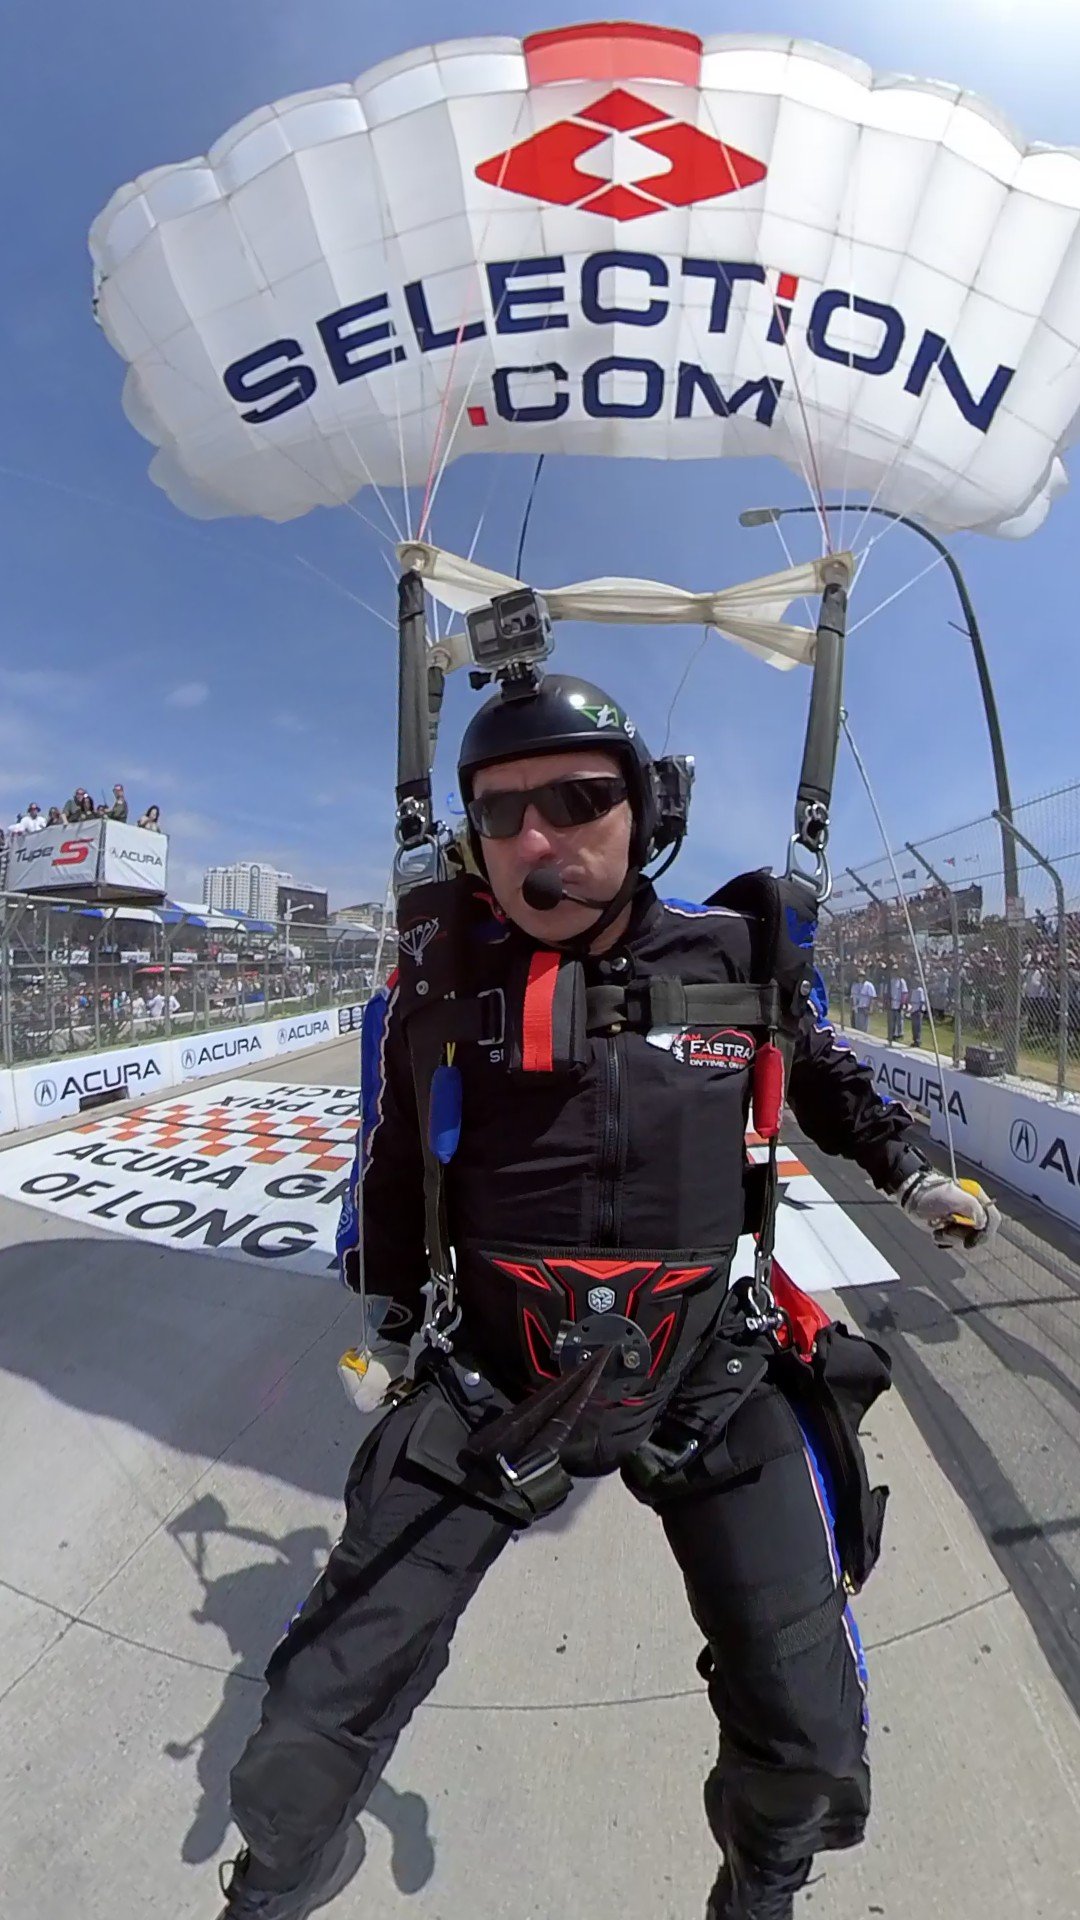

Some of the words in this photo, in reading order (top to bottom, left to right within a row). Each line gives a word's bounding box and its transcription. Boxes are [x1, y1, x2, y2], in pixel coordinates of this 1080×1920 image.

[119, 849, 163, 867] ACURA
[287, 1018, 330, 1042] ACURA
[198, 1035, 262, 1065] ACURA
[690, 1040, 752, 1059] FASTRA
[60, 1059, 161, 1100] ACURA
[267, 1086, 361, 1098] ACH
[207, 1096, 315, 1112] PRIX
[876, 1063, 968, 1125] ACURA
[55, 1142, 247, 1189] ACURA
[20, 1173, 114, 1201] OF
[88, 1190, 320, 1258] LONG
